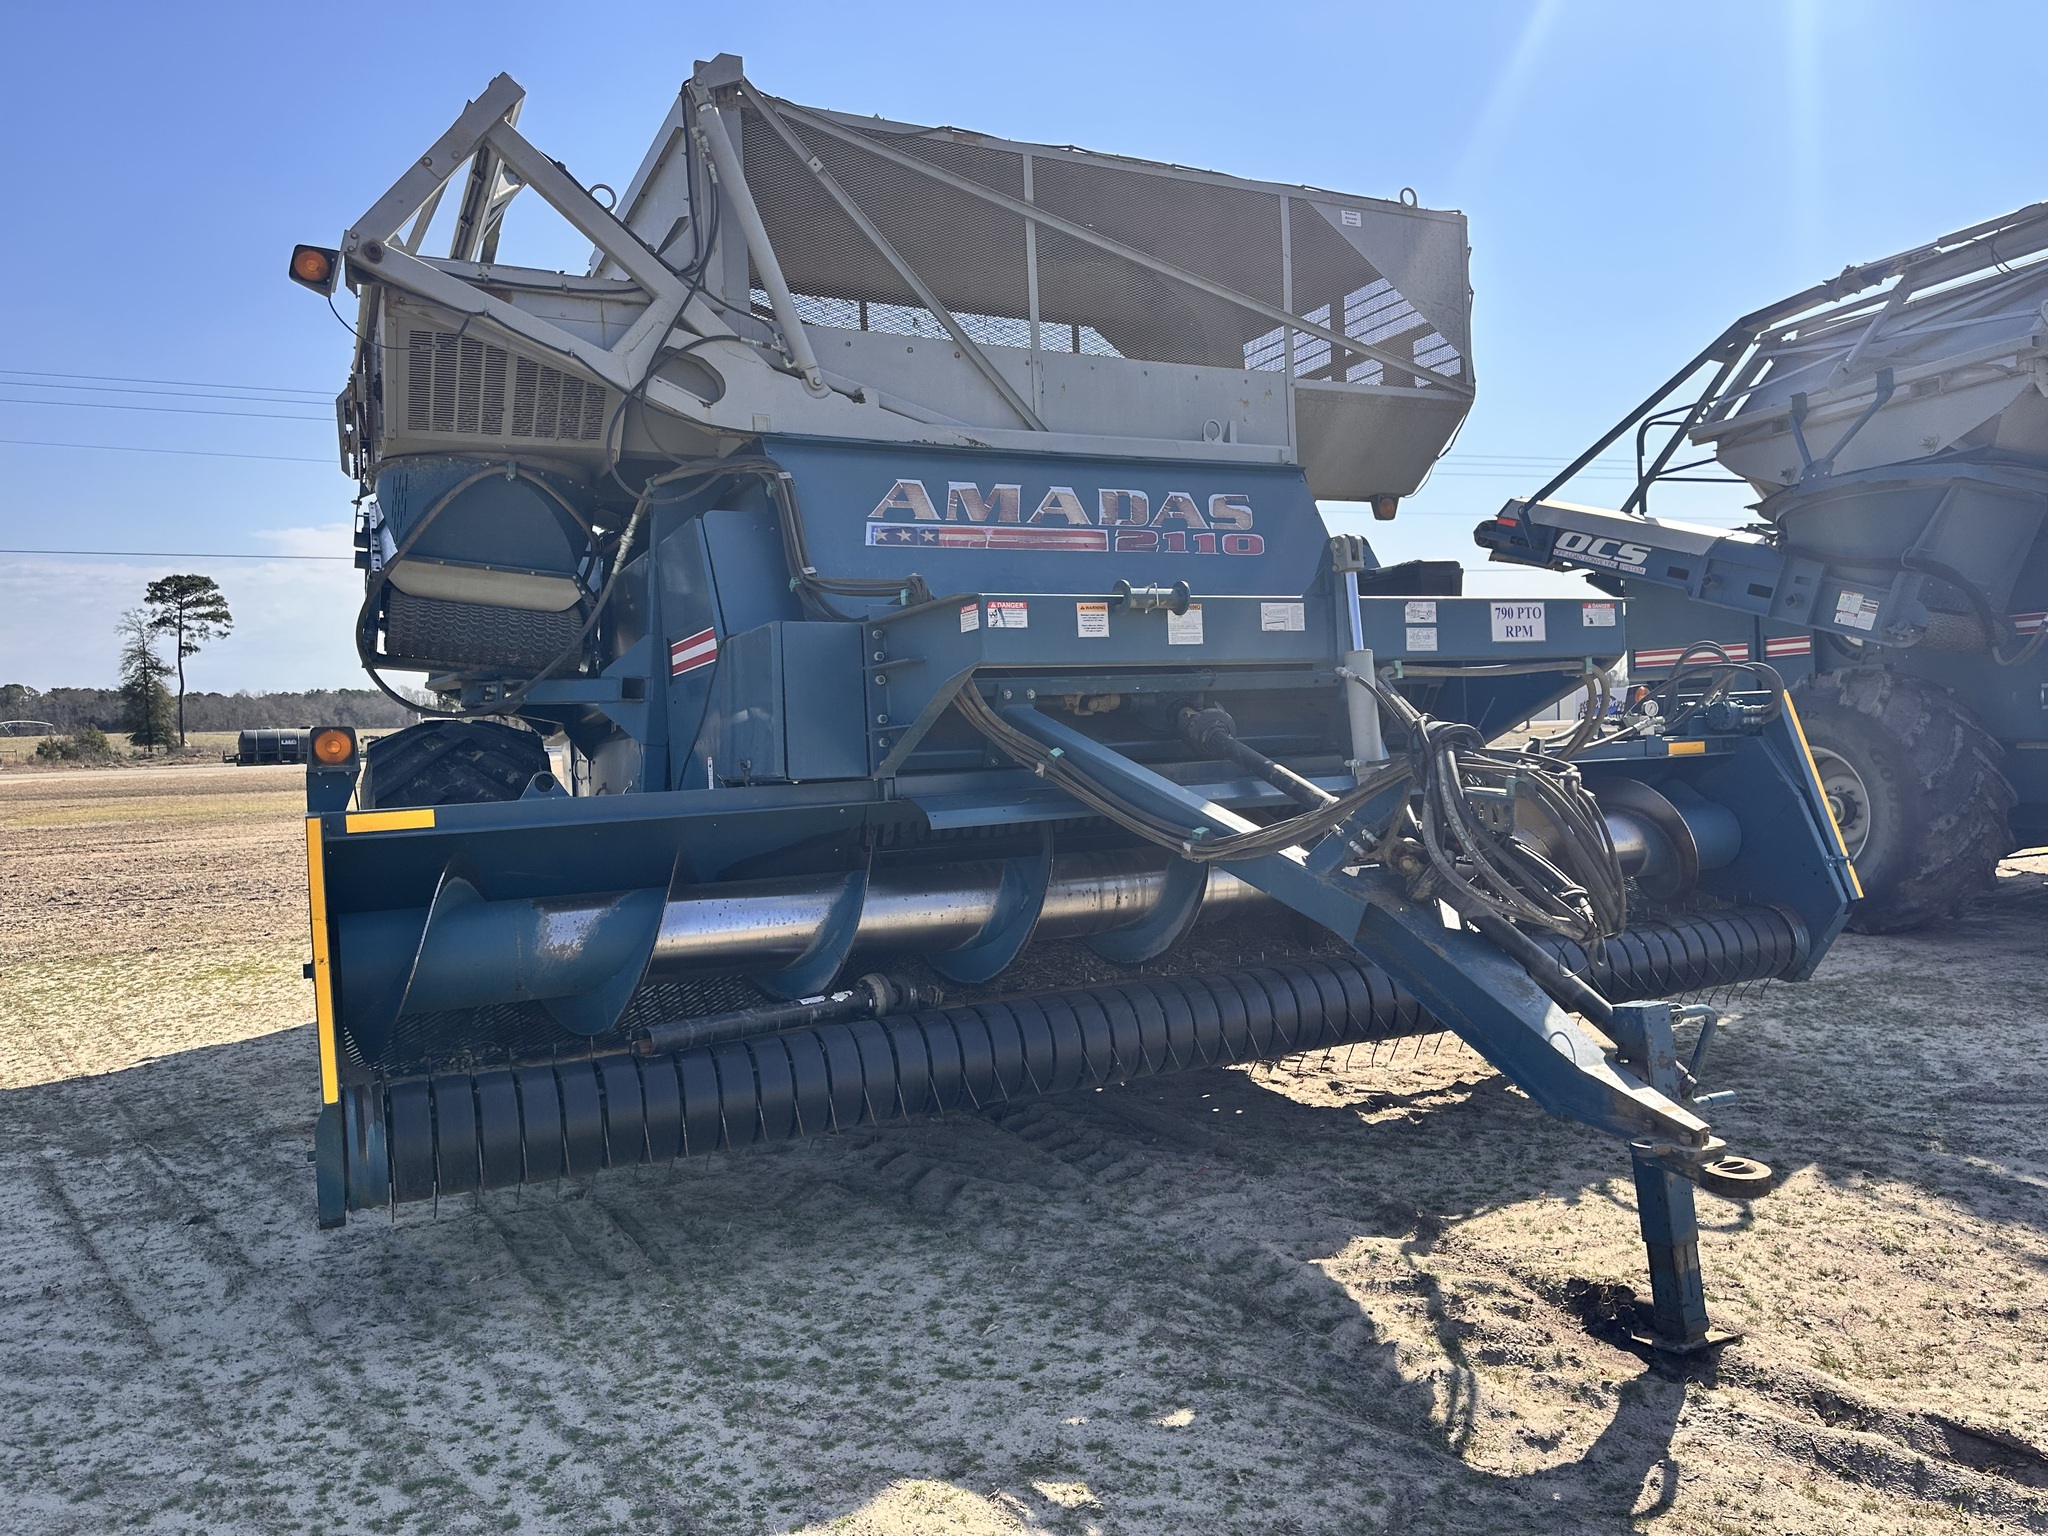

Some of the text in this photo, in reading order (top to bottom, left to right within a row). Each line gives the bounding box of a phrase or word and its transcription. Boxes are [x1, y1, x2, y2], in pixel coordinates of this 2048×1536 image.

[867, 479, 1253, 530] AMADAS
[1115, 530, 1265, 555] 2110
[1555, 531, 1652, 565] OCS
[1619, 563, 1644, 573] SYSTEM
[1495, 606, 1542, 620] 790 PTO
[1506, 625, 1533, 638] RPM
